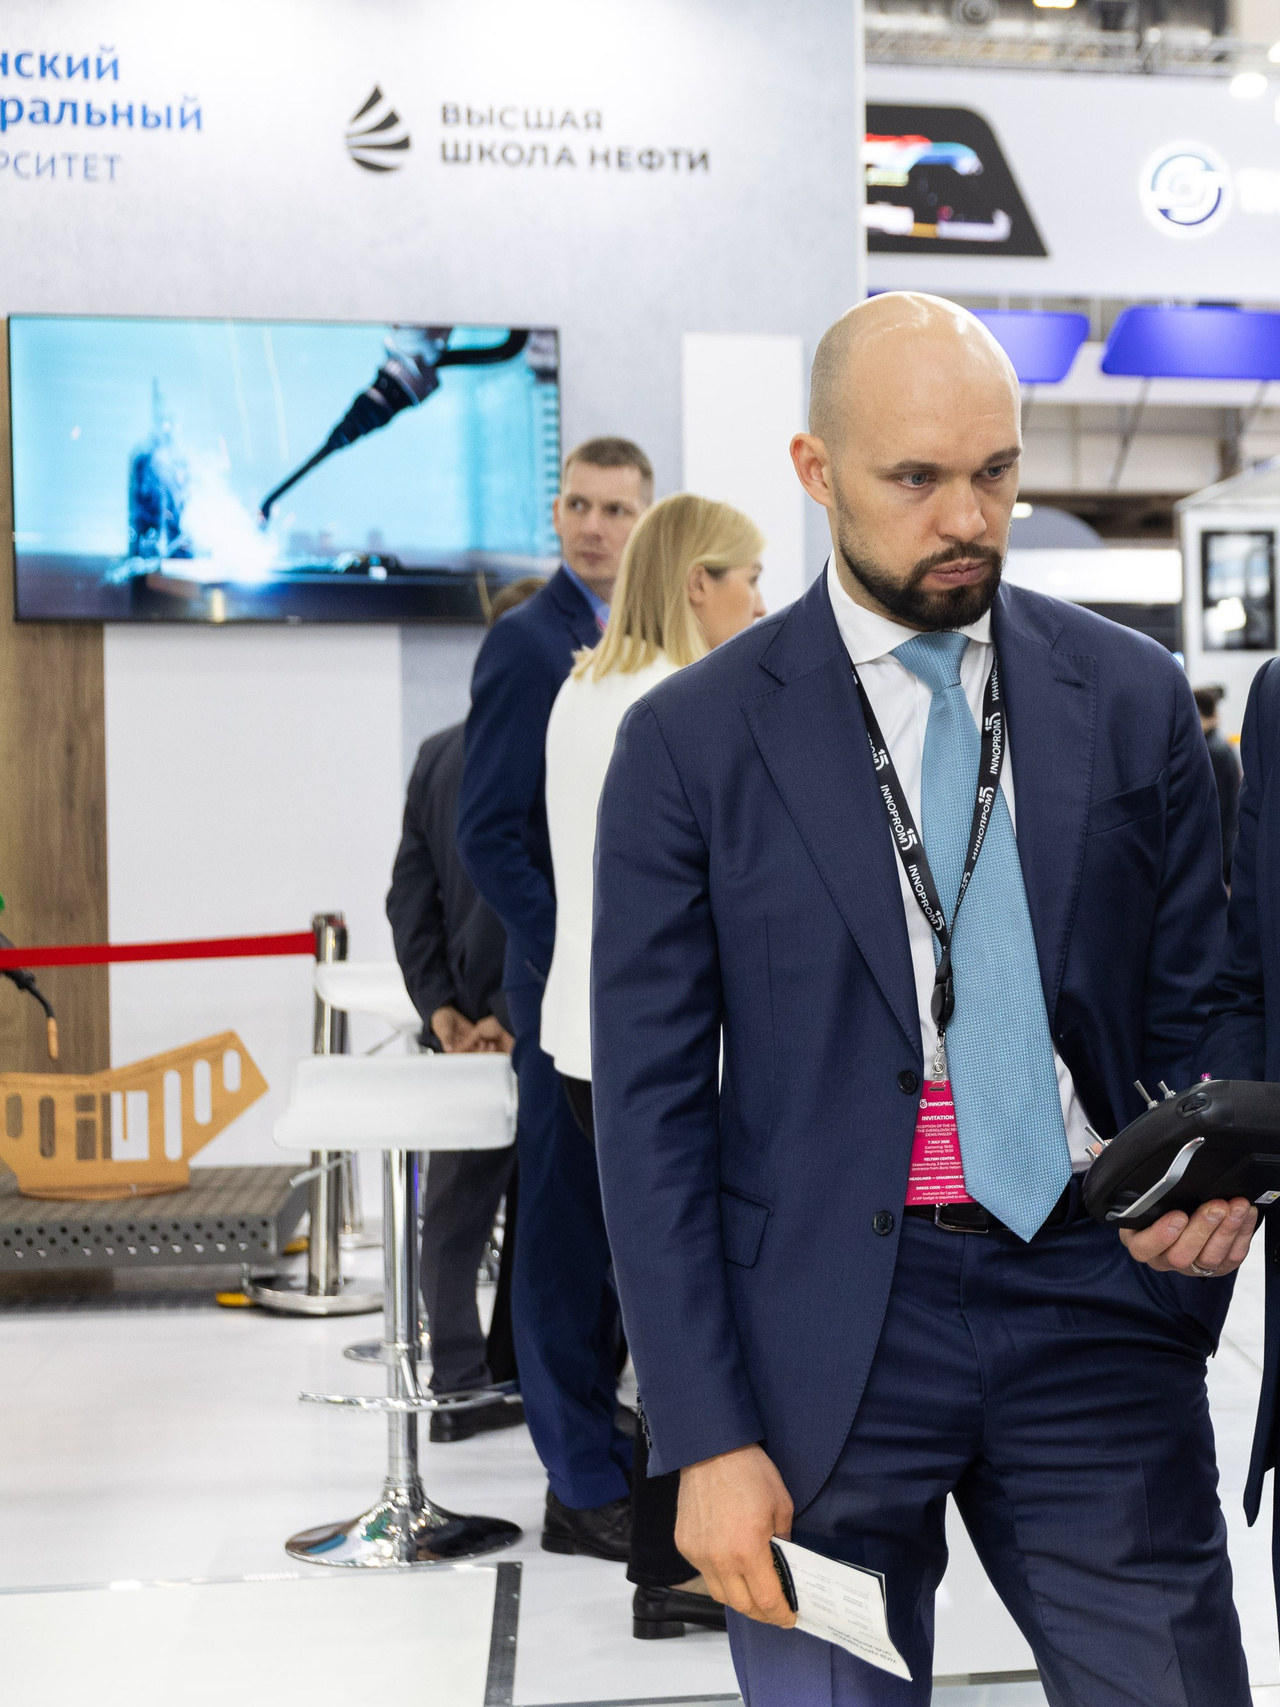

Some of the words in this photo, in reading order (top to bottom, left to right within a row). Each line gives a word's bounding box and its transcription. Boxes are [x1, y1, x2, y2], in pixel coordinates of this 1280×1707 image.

[441, 101, 603, 131] ВЫСШАЯ
[441, 141, 576, 168] ШКОЛА
[590, 147, 710, 173] НЕФТИ
[989, 718, 1002, 775] INNOPROM
[880, 784, 908, 844] INNOPROM
[971, 793, 993, 861] ИННОПРОМ
[908, 864, 938, 925] INNOPROM
